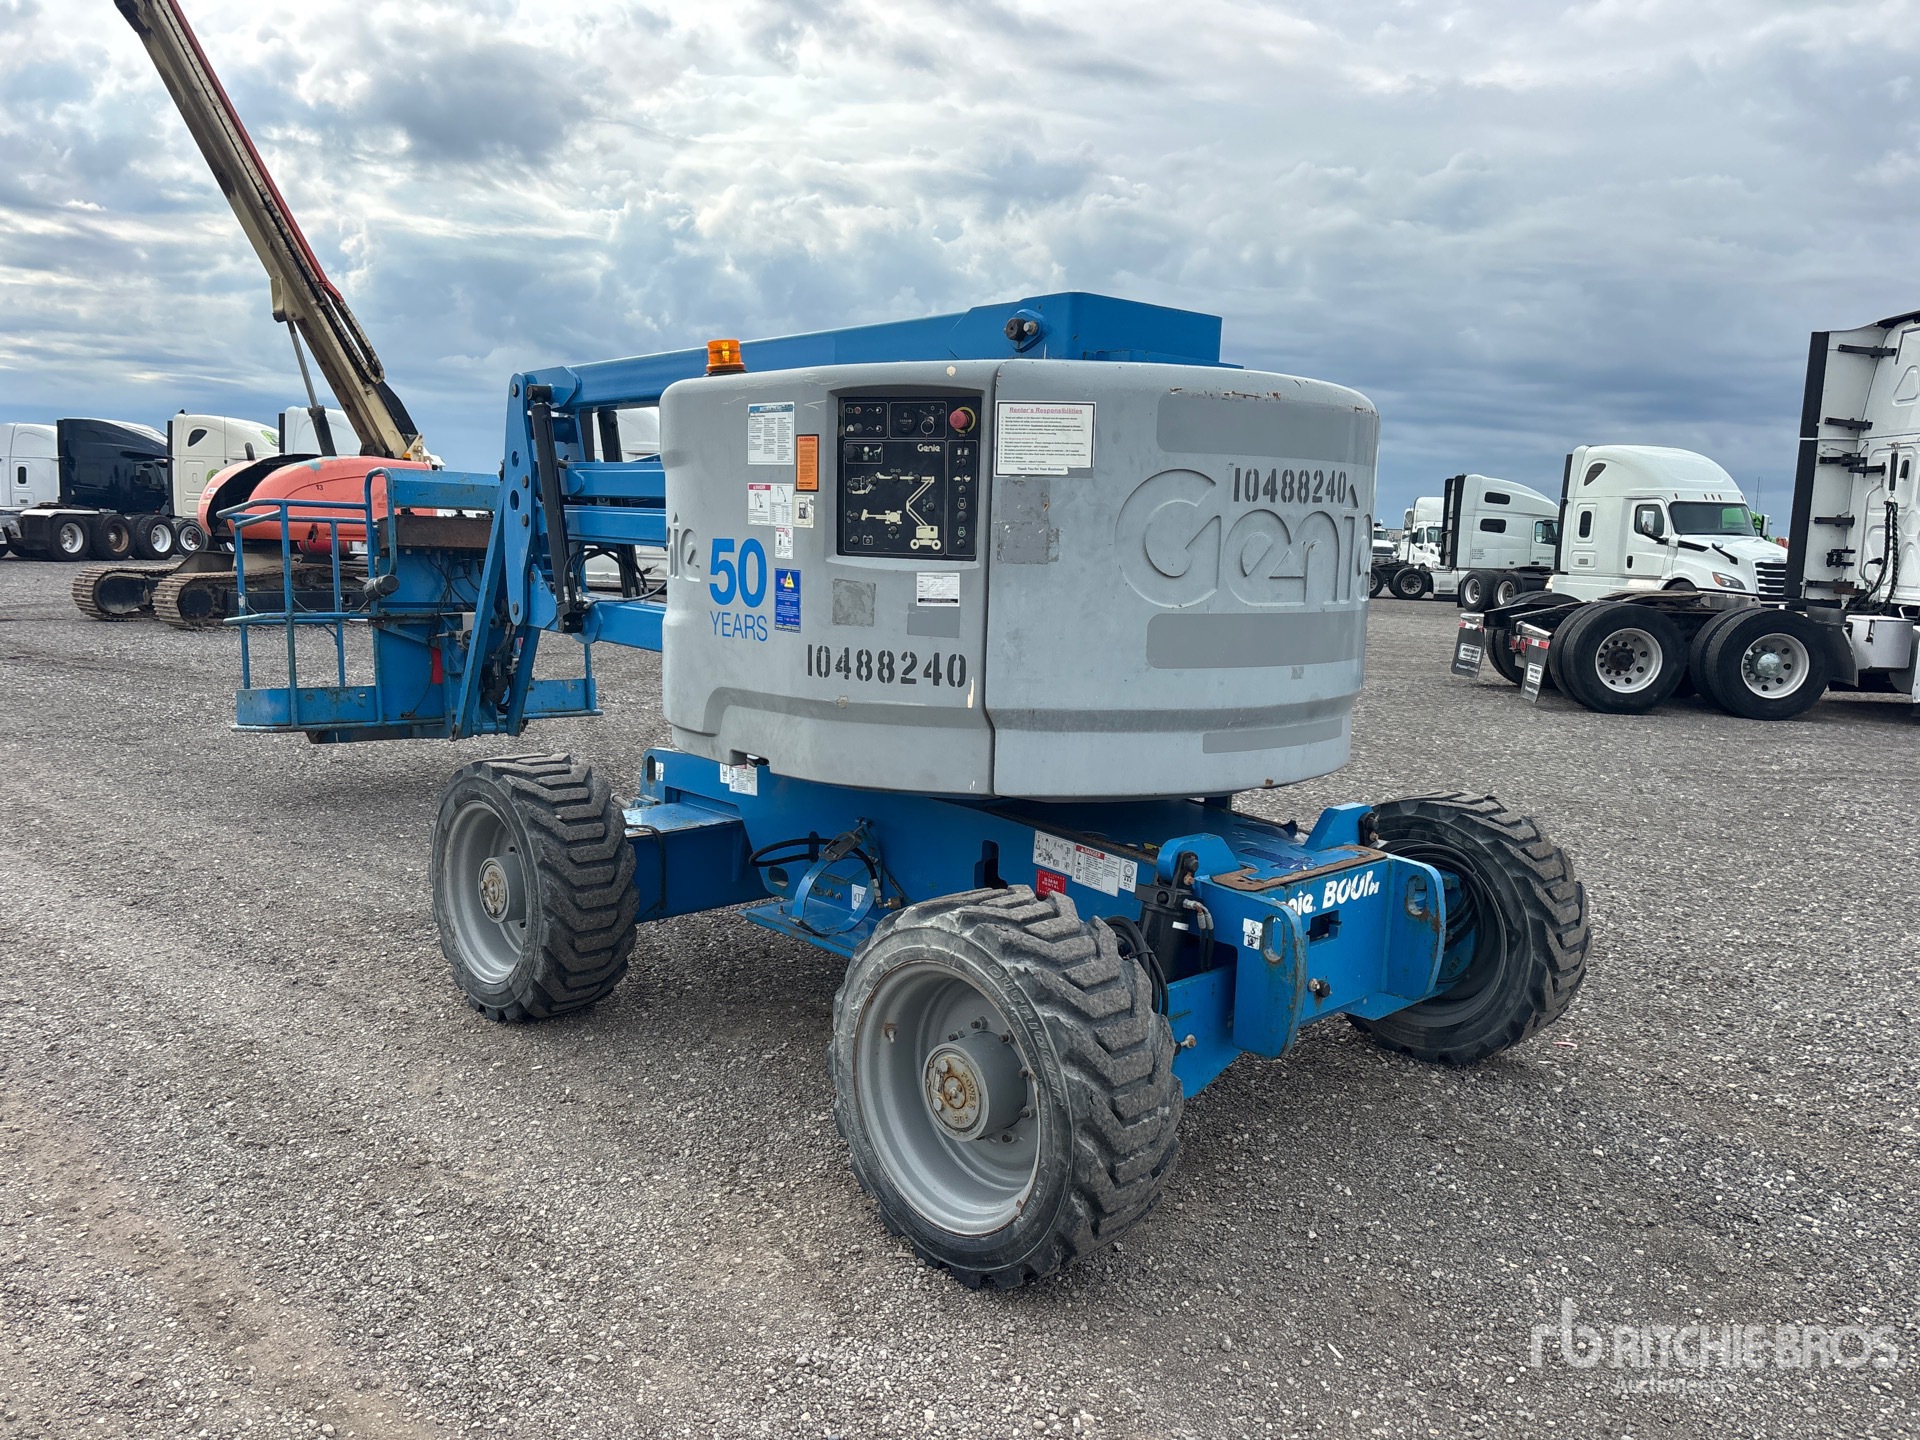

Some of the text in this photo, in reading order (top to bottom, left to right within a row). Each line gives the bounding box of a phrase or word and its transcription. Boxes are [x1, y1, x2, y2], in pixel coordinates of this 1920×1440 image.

[1035, 407, 1083, 415] Responsibilities
[917, 443, 941, 452] Genie
[1233, 467, 1347, 504] 10488240
[709, 538, 767, 608] 50
[710, 610, 768, 642] YEARS
[807, 644, 967, 688] 10488240
